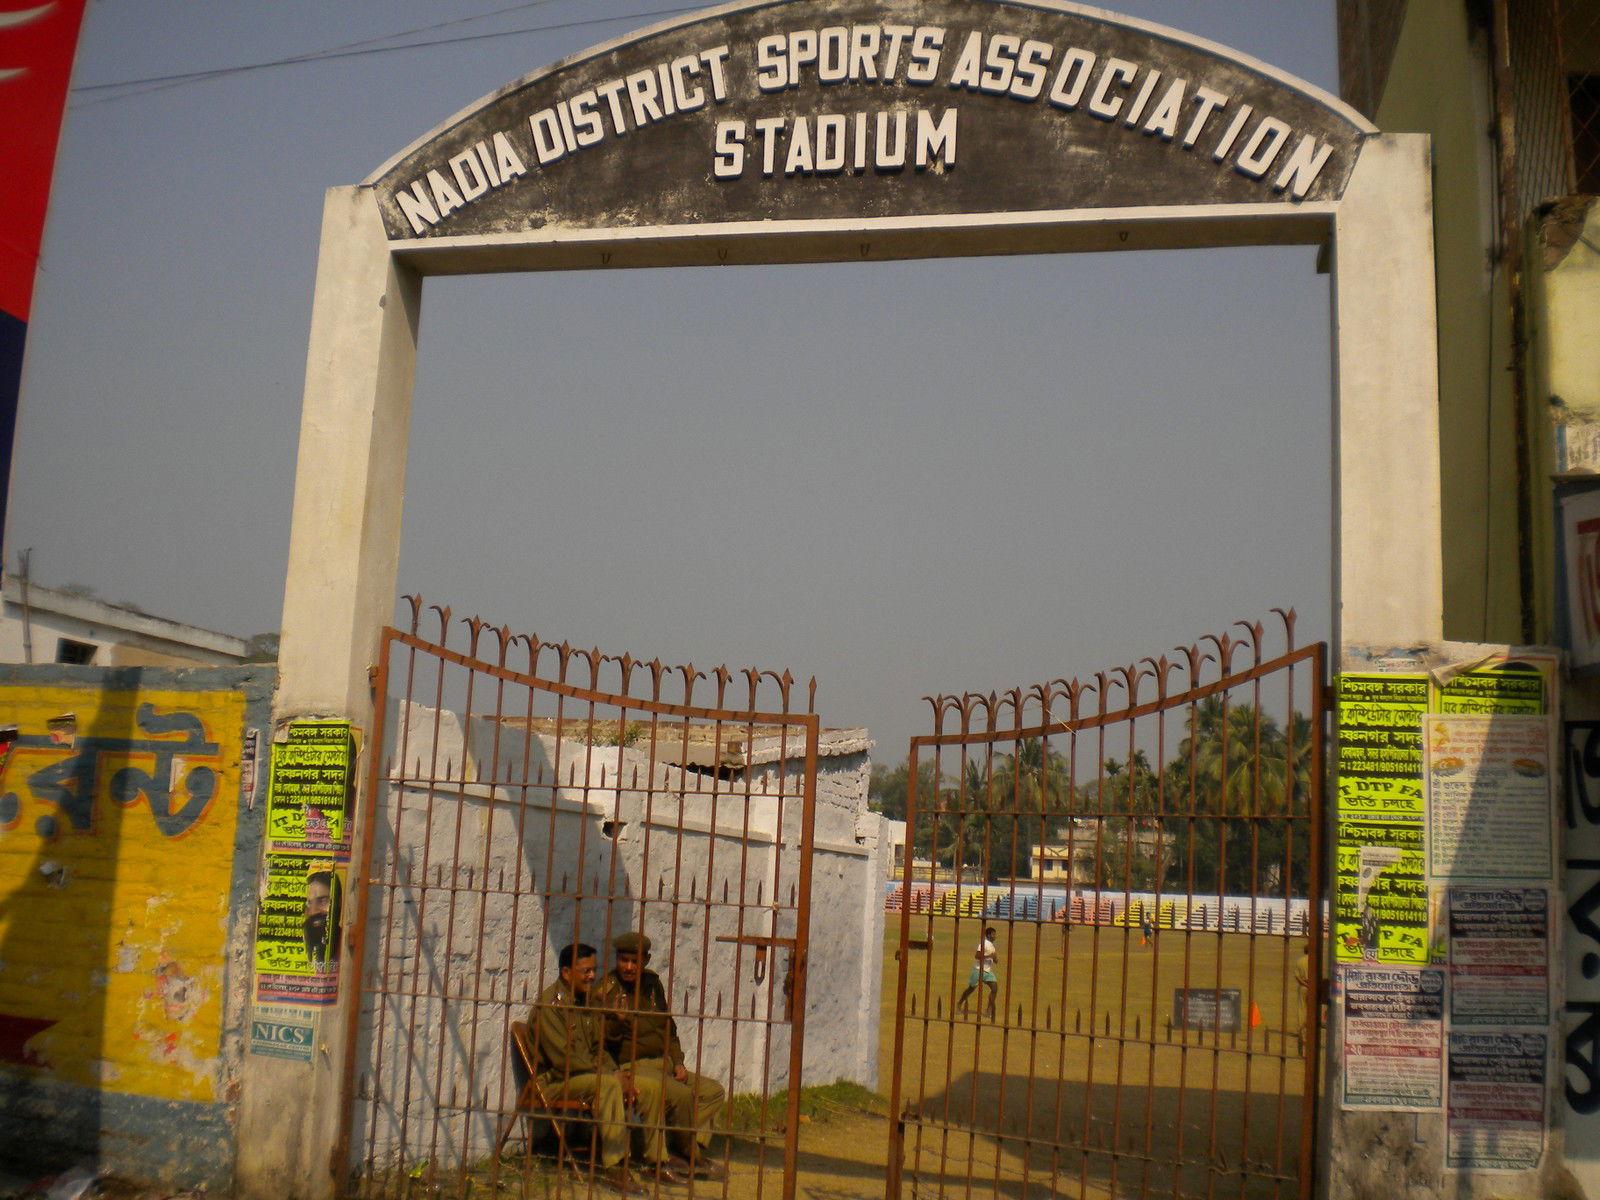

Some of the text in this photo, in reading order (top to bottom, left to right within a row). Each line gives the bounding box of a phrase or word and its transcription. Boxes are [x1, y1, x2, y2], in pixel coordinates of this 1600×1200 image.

[395, 25, 1334, 235] NADIA DISTRICT SPORTS ASSOCIATION
[714, 108, 958, 179] STADIUM
[1356, 781, 1394, 792] DTP
[277, 945, 305, 955] DTP
[255, 1023, 305, 1043] NICS
